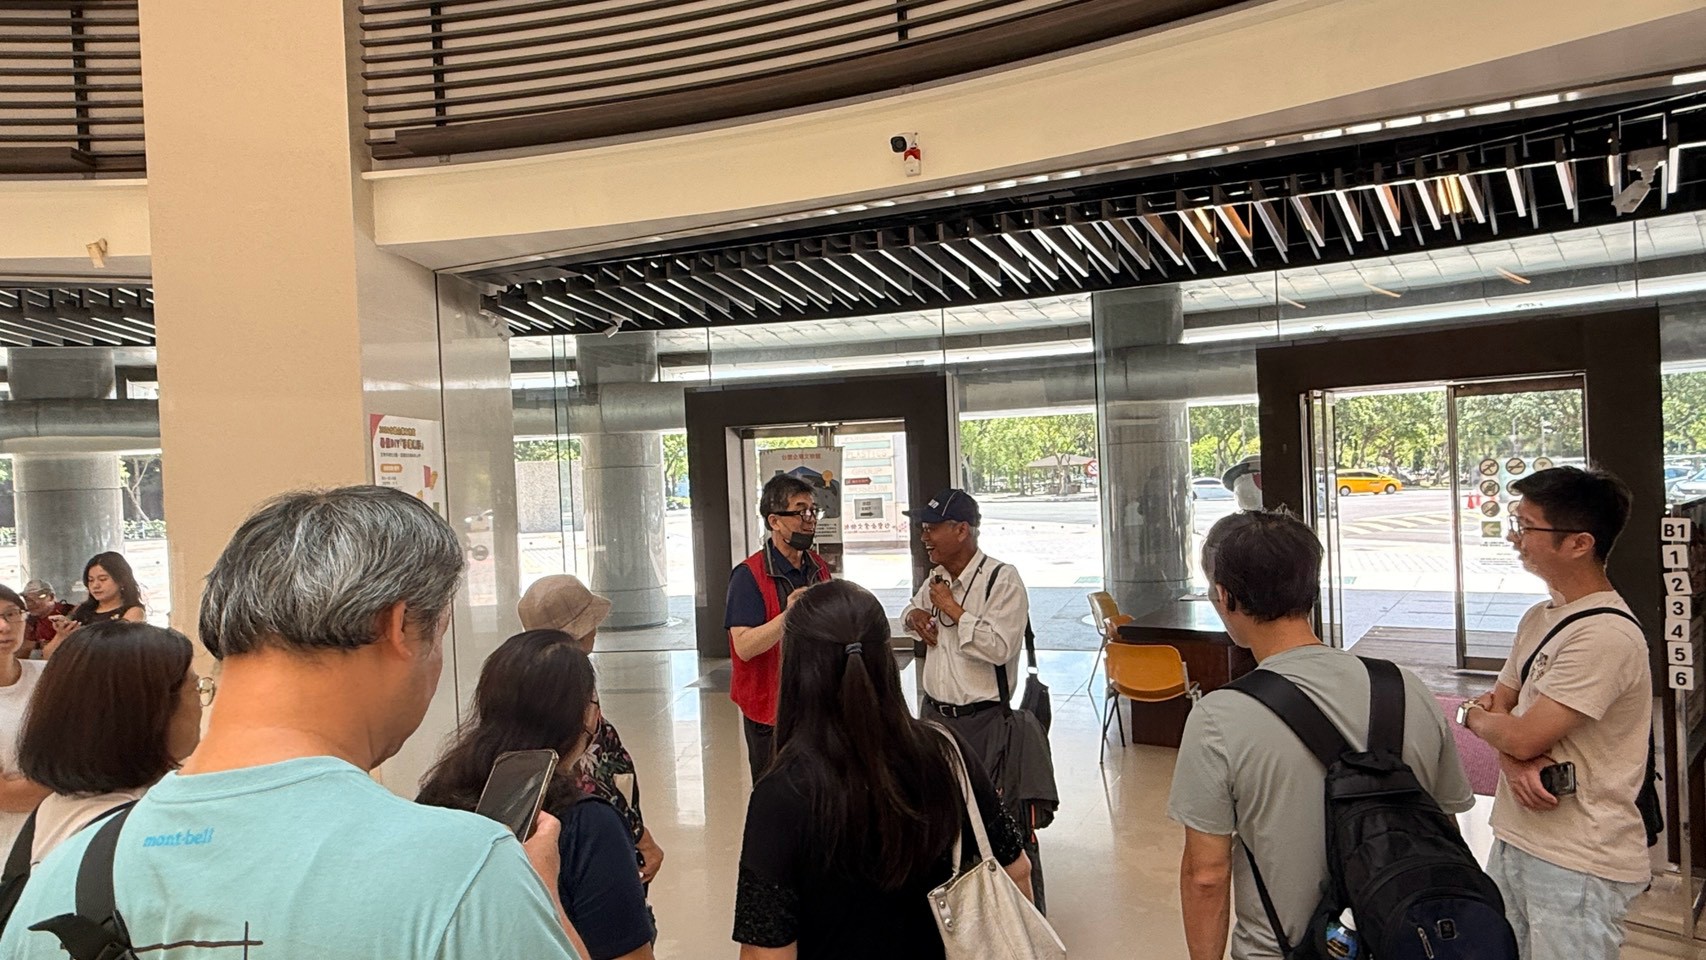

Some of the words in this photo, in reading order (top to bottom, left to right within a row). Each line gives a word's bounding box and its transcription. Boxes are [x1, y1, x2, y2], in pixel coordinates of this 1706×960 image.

[1664, 524, 1685, 538] B1
[1670, 551, 1679, 565] 1
[1671, 578, 1684, 592] 2
[1673, 601, 1684, 616] 3
[1671, 625, 1683, 639] 4
[1675, 648, 1686, 662] 5
[1675, 672, 1687, 686] 6
